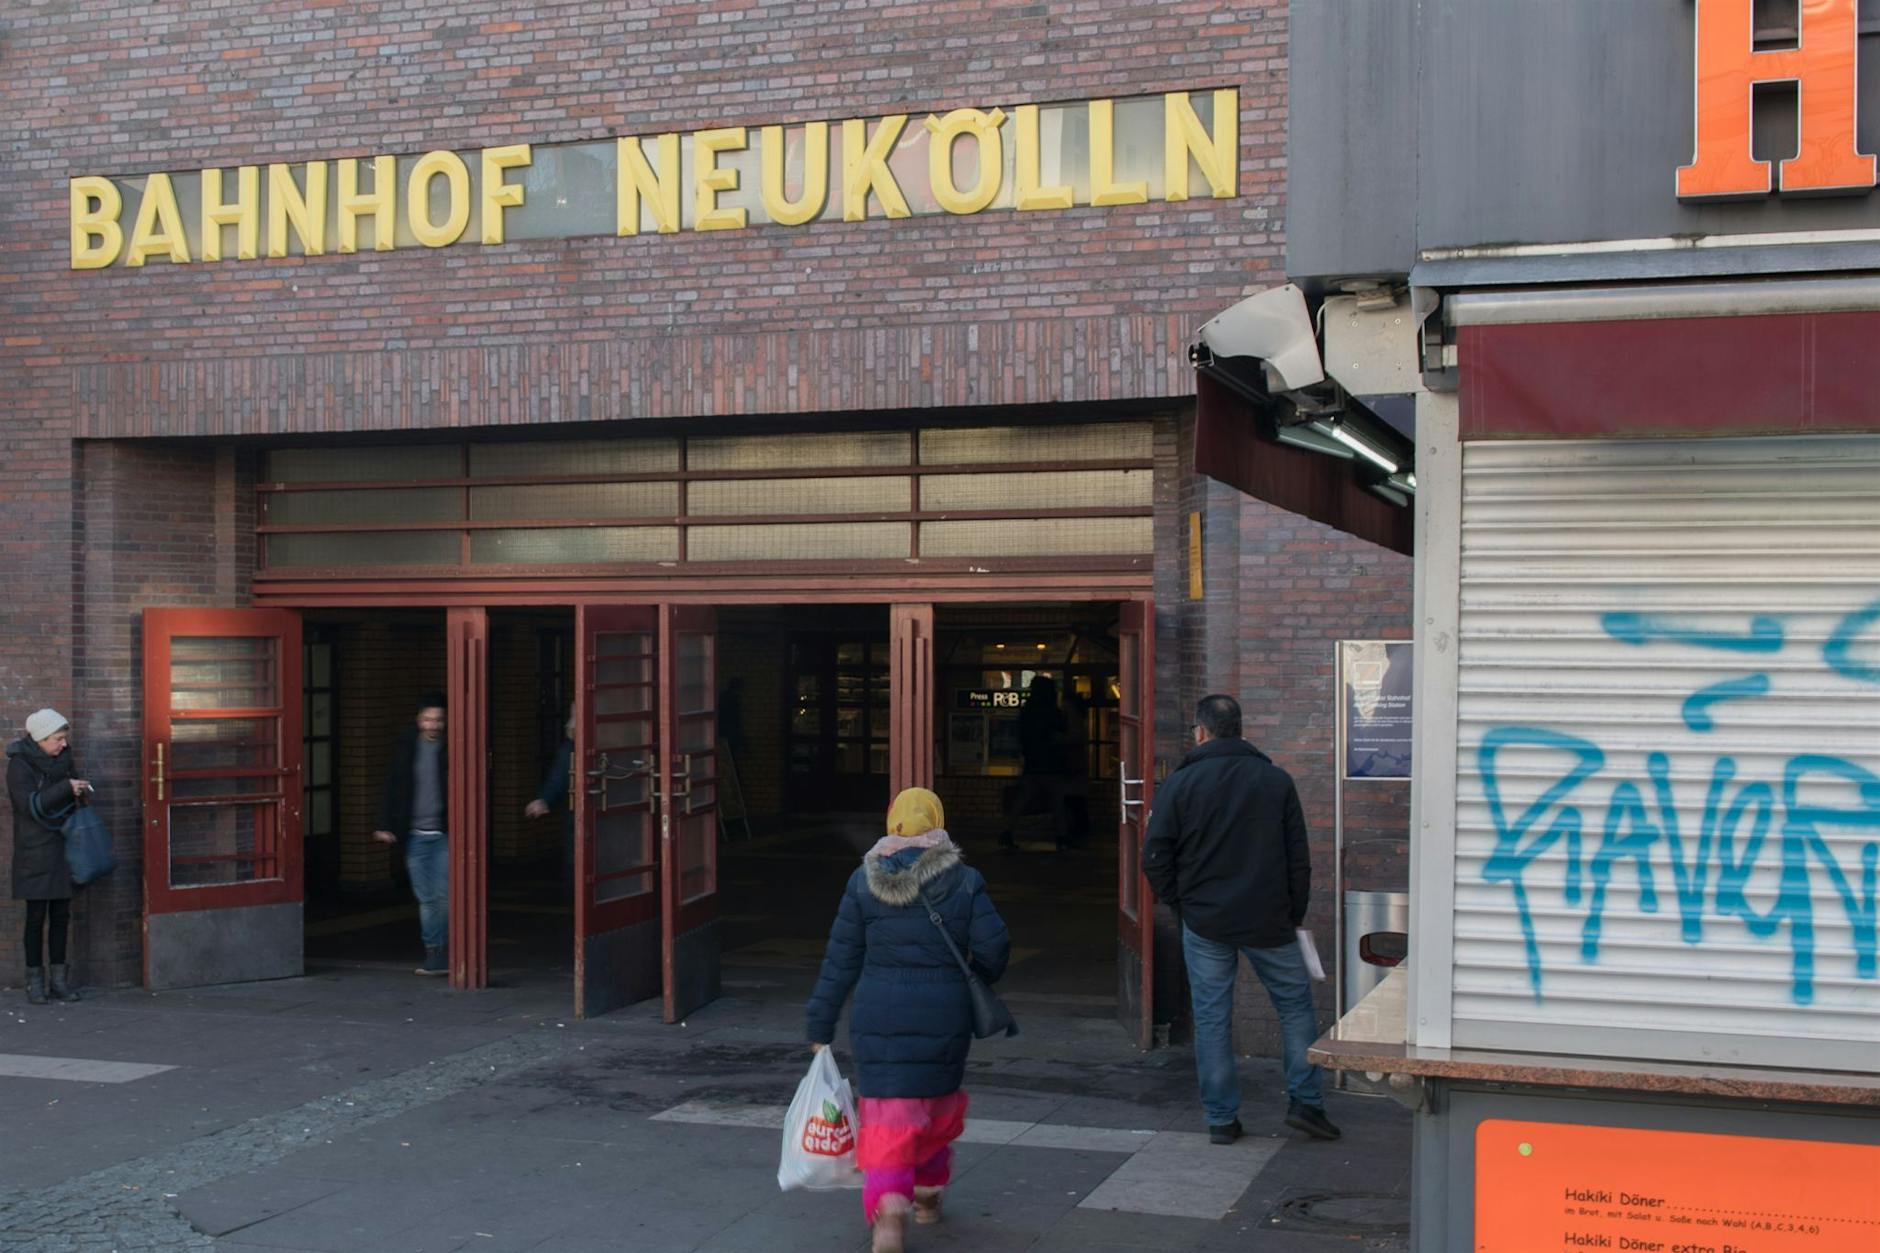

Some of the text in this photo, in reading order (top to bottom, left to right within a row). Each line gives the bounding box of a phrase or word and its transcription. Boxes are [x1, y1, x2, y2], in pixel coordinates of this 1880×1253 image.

[70, 88, 1239, 270] BAHNHOF NEUKÖLLN
[1564, 1187, 1665, 1209] Hakiki Döner
[1607, 1210, 1622, 1218] mit
[1627, 1211, 1652, 1221] Salat
[1696, 1217, 1719, 1226] nach
[1722, 1218, 1747, 1228] Wahl
[1564, 1231, 1612, 1248] Hakiki
[1619, 1236, 1665, 1252] Döner
